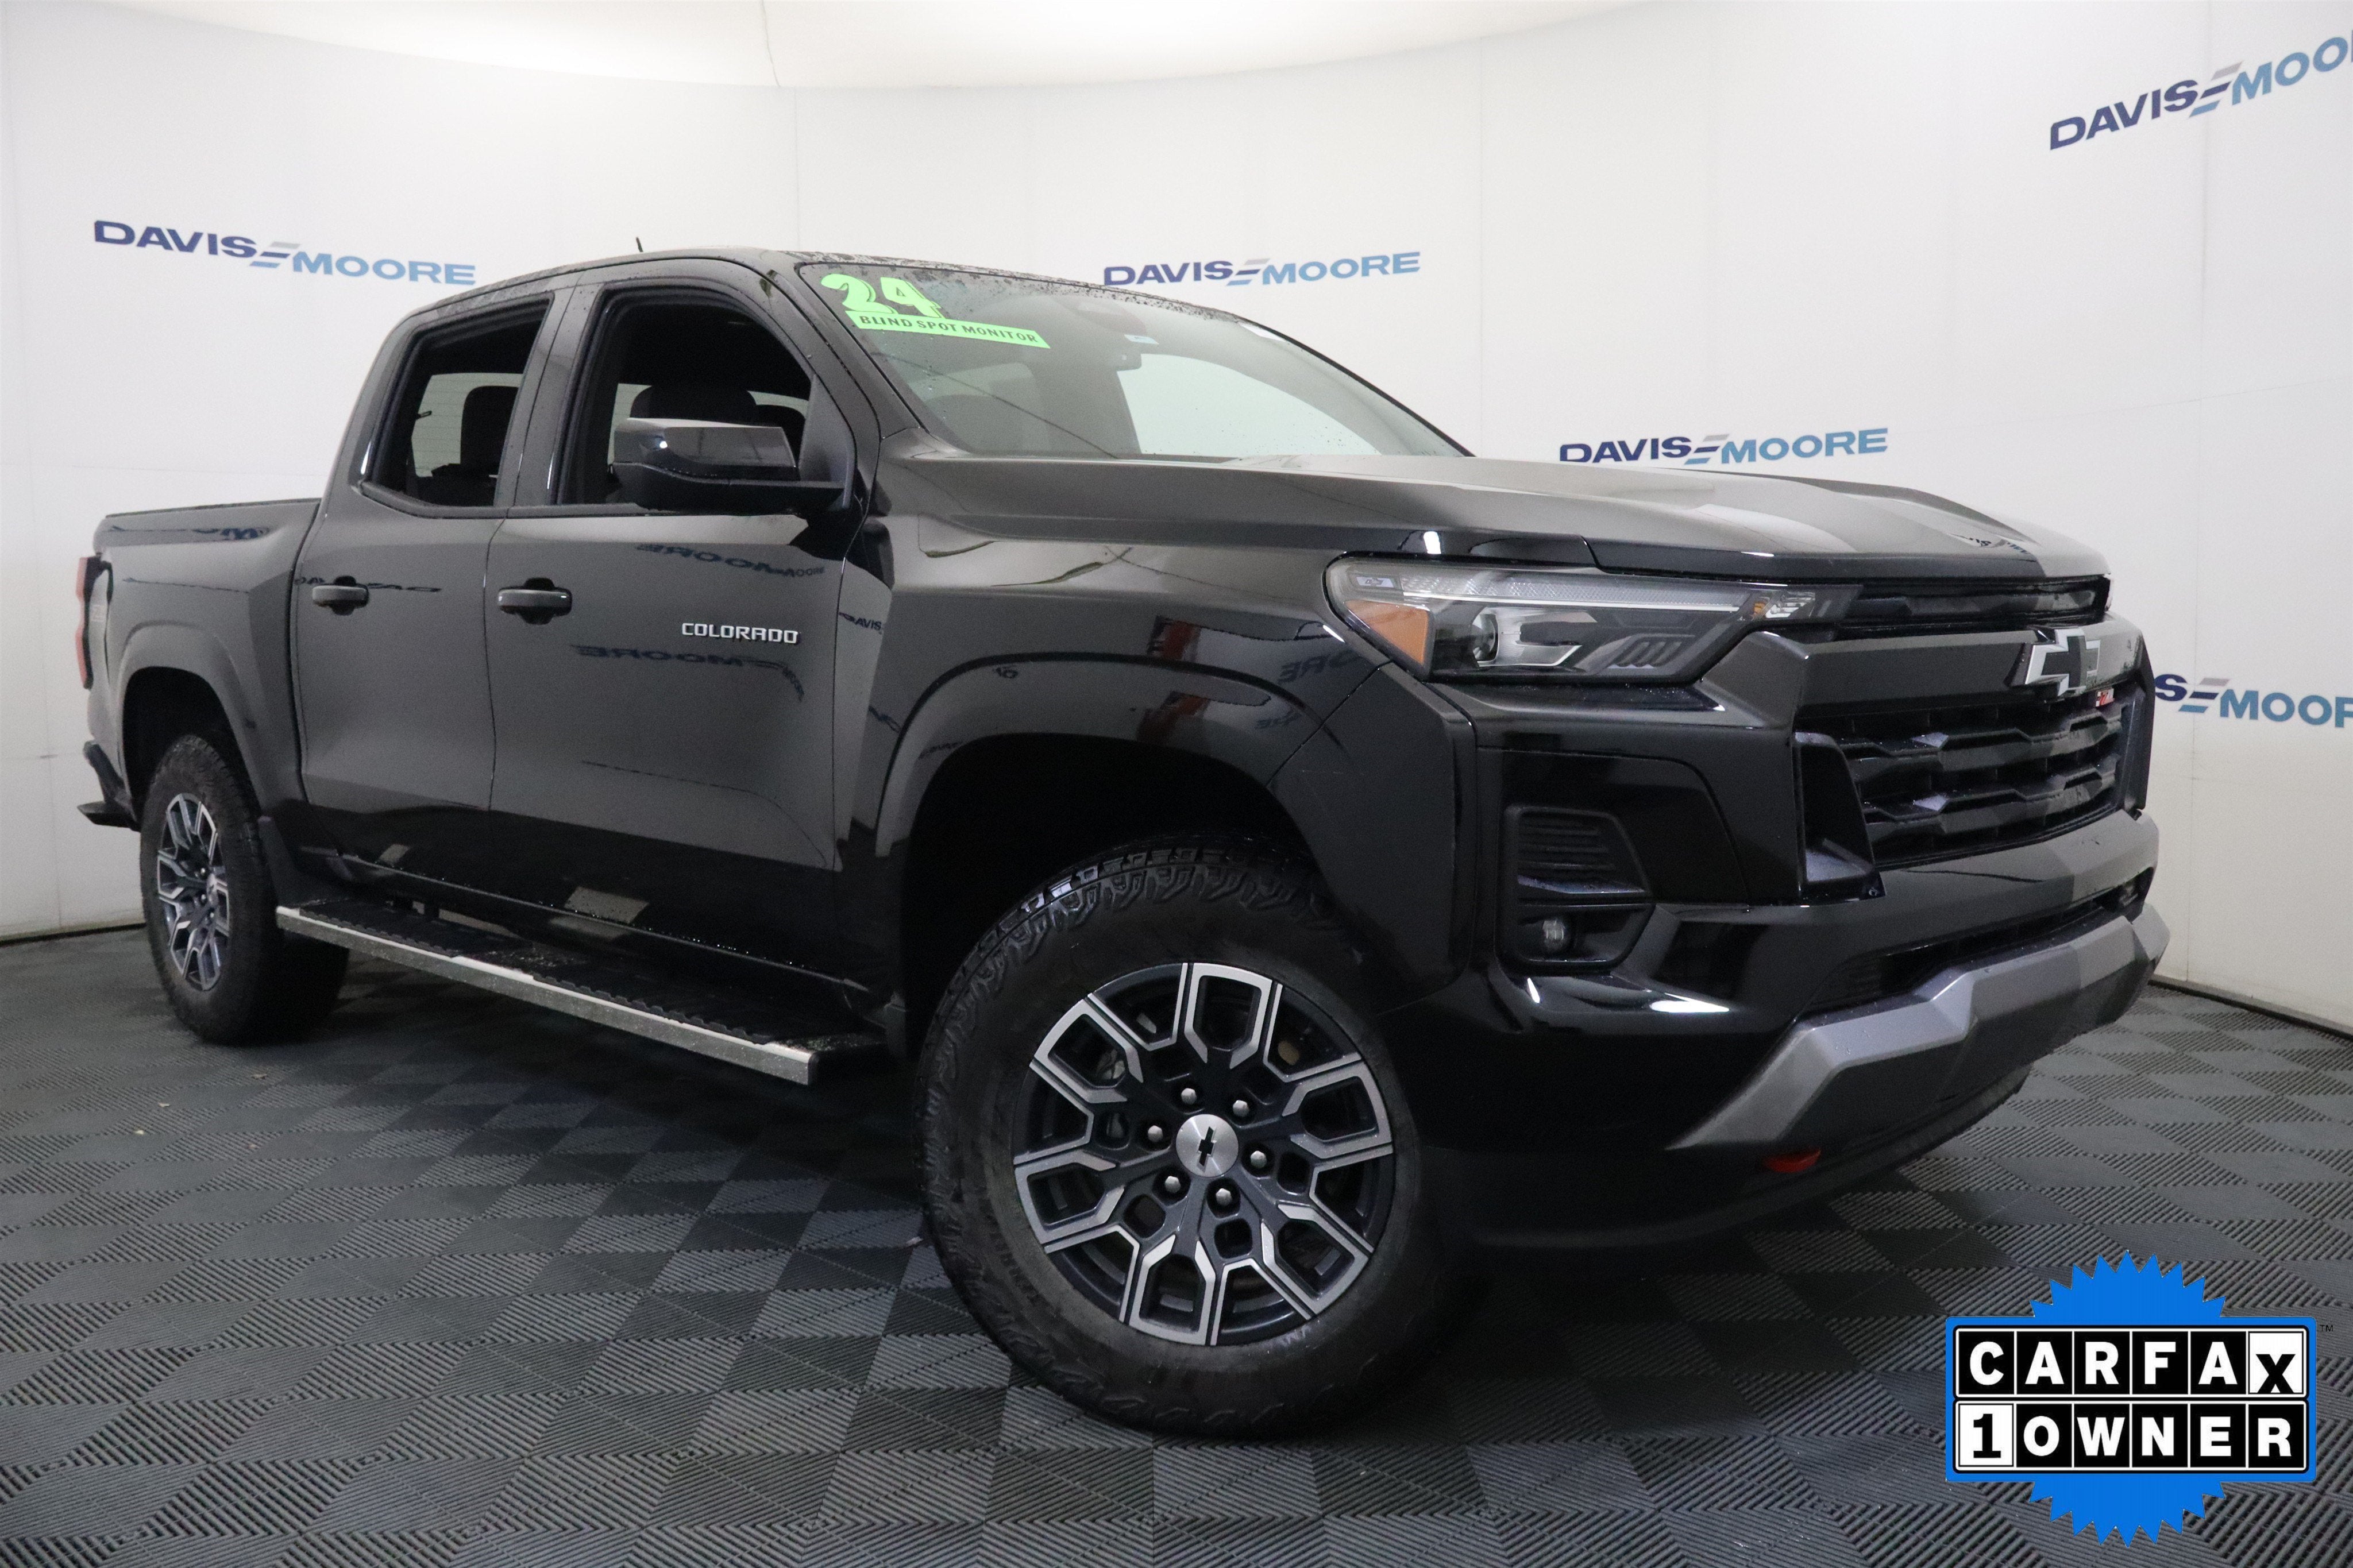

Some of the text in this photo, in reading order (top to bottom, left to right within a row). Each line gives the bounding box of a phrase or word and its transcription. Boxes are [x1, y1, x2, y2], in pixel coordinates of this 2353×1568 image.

[2050, 29, 2353, 150] DAVIS MOO
[94, 220, 477, 286] DAVIS MOORE
[1103, 251, 1421, 287] DAVIS MOORE
[820, 273, 946, 319] 24
[859, 315, 1039, 343] BLIND SPOT MONITOR
[1559, 427, 1888, 464] DAVIS MOORE
[681, 622, 799, 644] COLORADO
